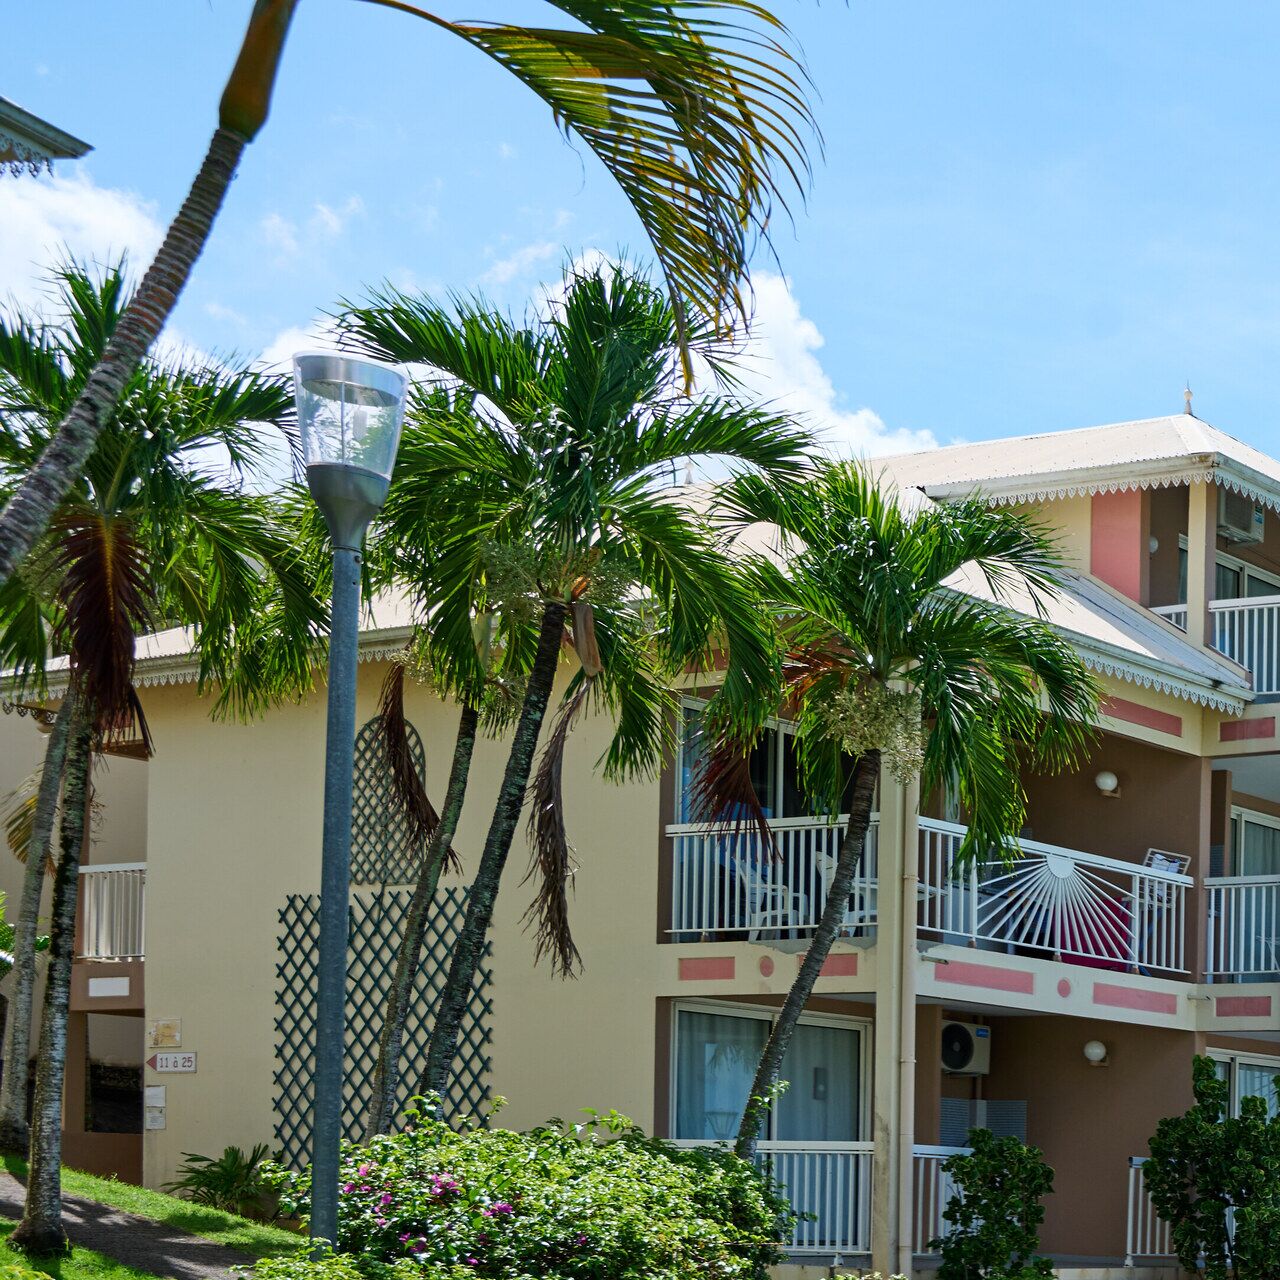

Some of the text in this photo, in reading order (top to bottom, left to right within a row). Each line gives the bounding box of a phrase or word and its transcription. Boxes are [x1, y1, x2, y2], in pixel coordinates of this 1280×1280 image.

[159, 1056, 193, 1068] 11 à 25
